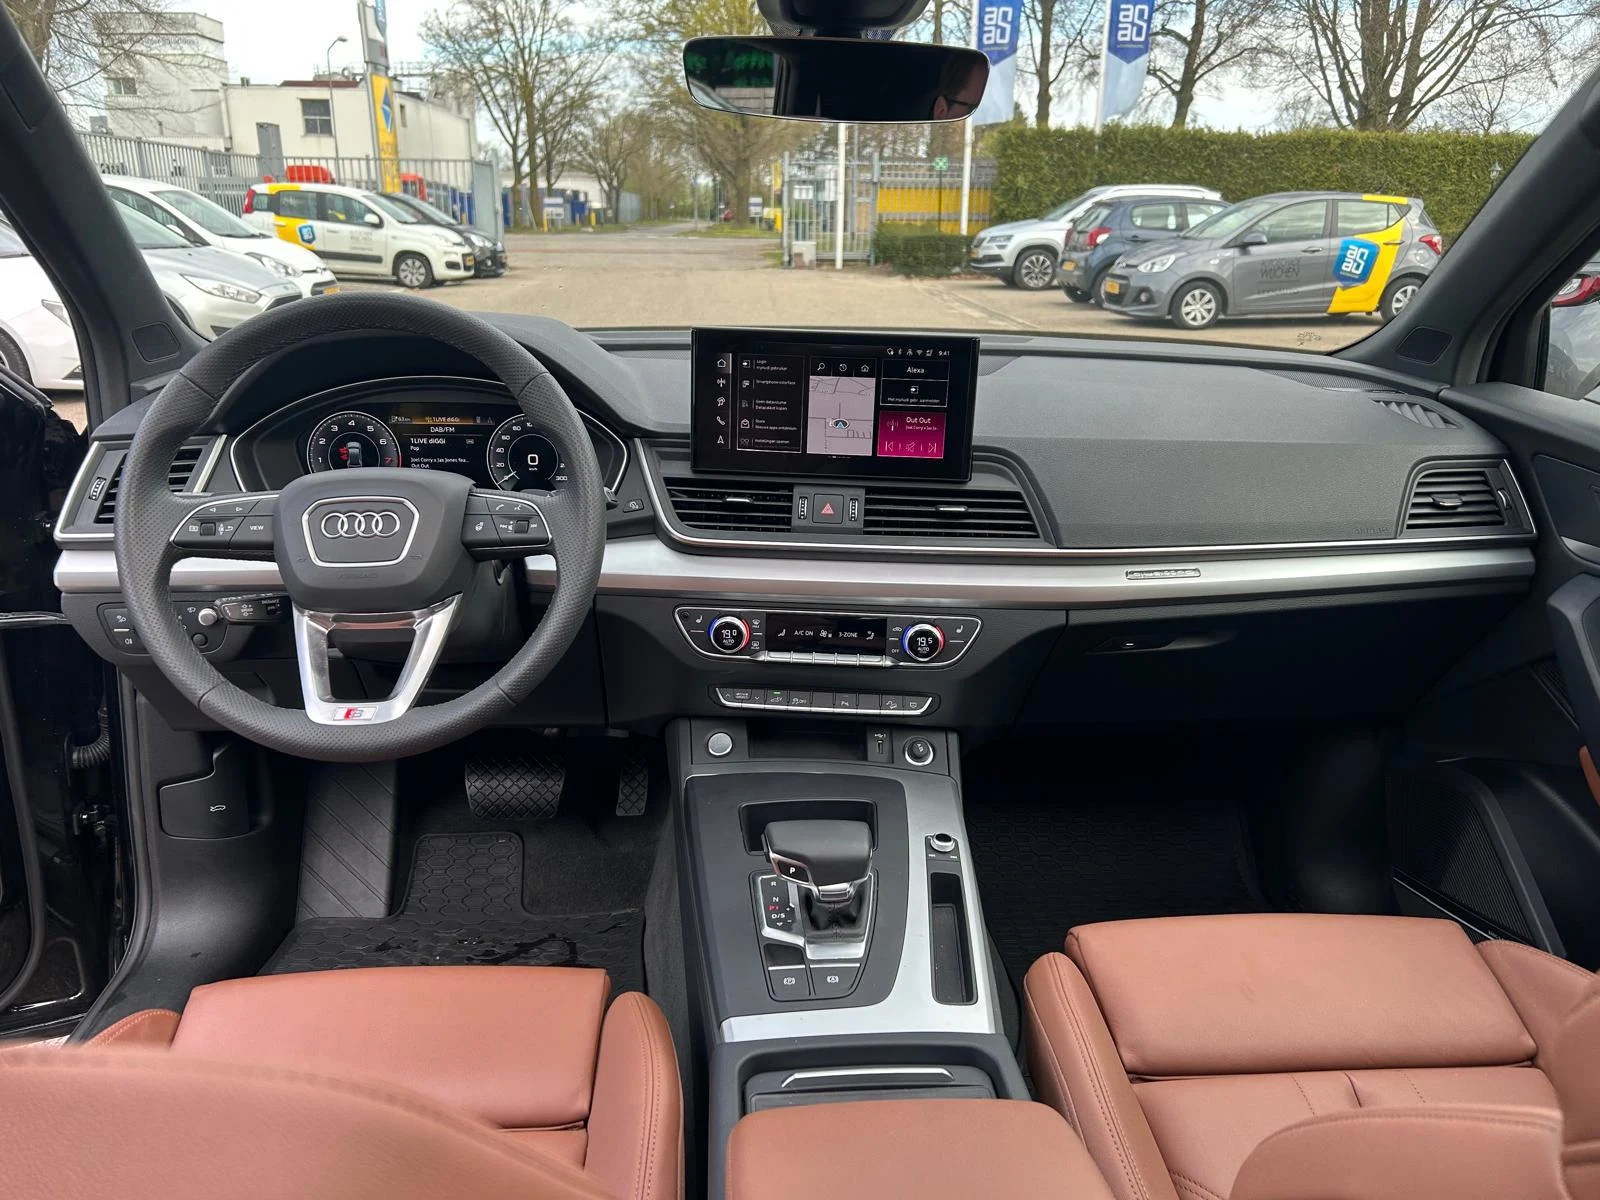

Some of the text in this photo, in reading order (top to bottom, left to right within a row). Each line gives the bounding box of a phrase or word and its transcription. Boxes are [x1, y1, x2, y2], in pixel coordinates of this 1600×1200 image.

[906, 366, 925, 374] Alexa
[906, 416, 918, 424] Out
[527, 454, 539, 465] 0
